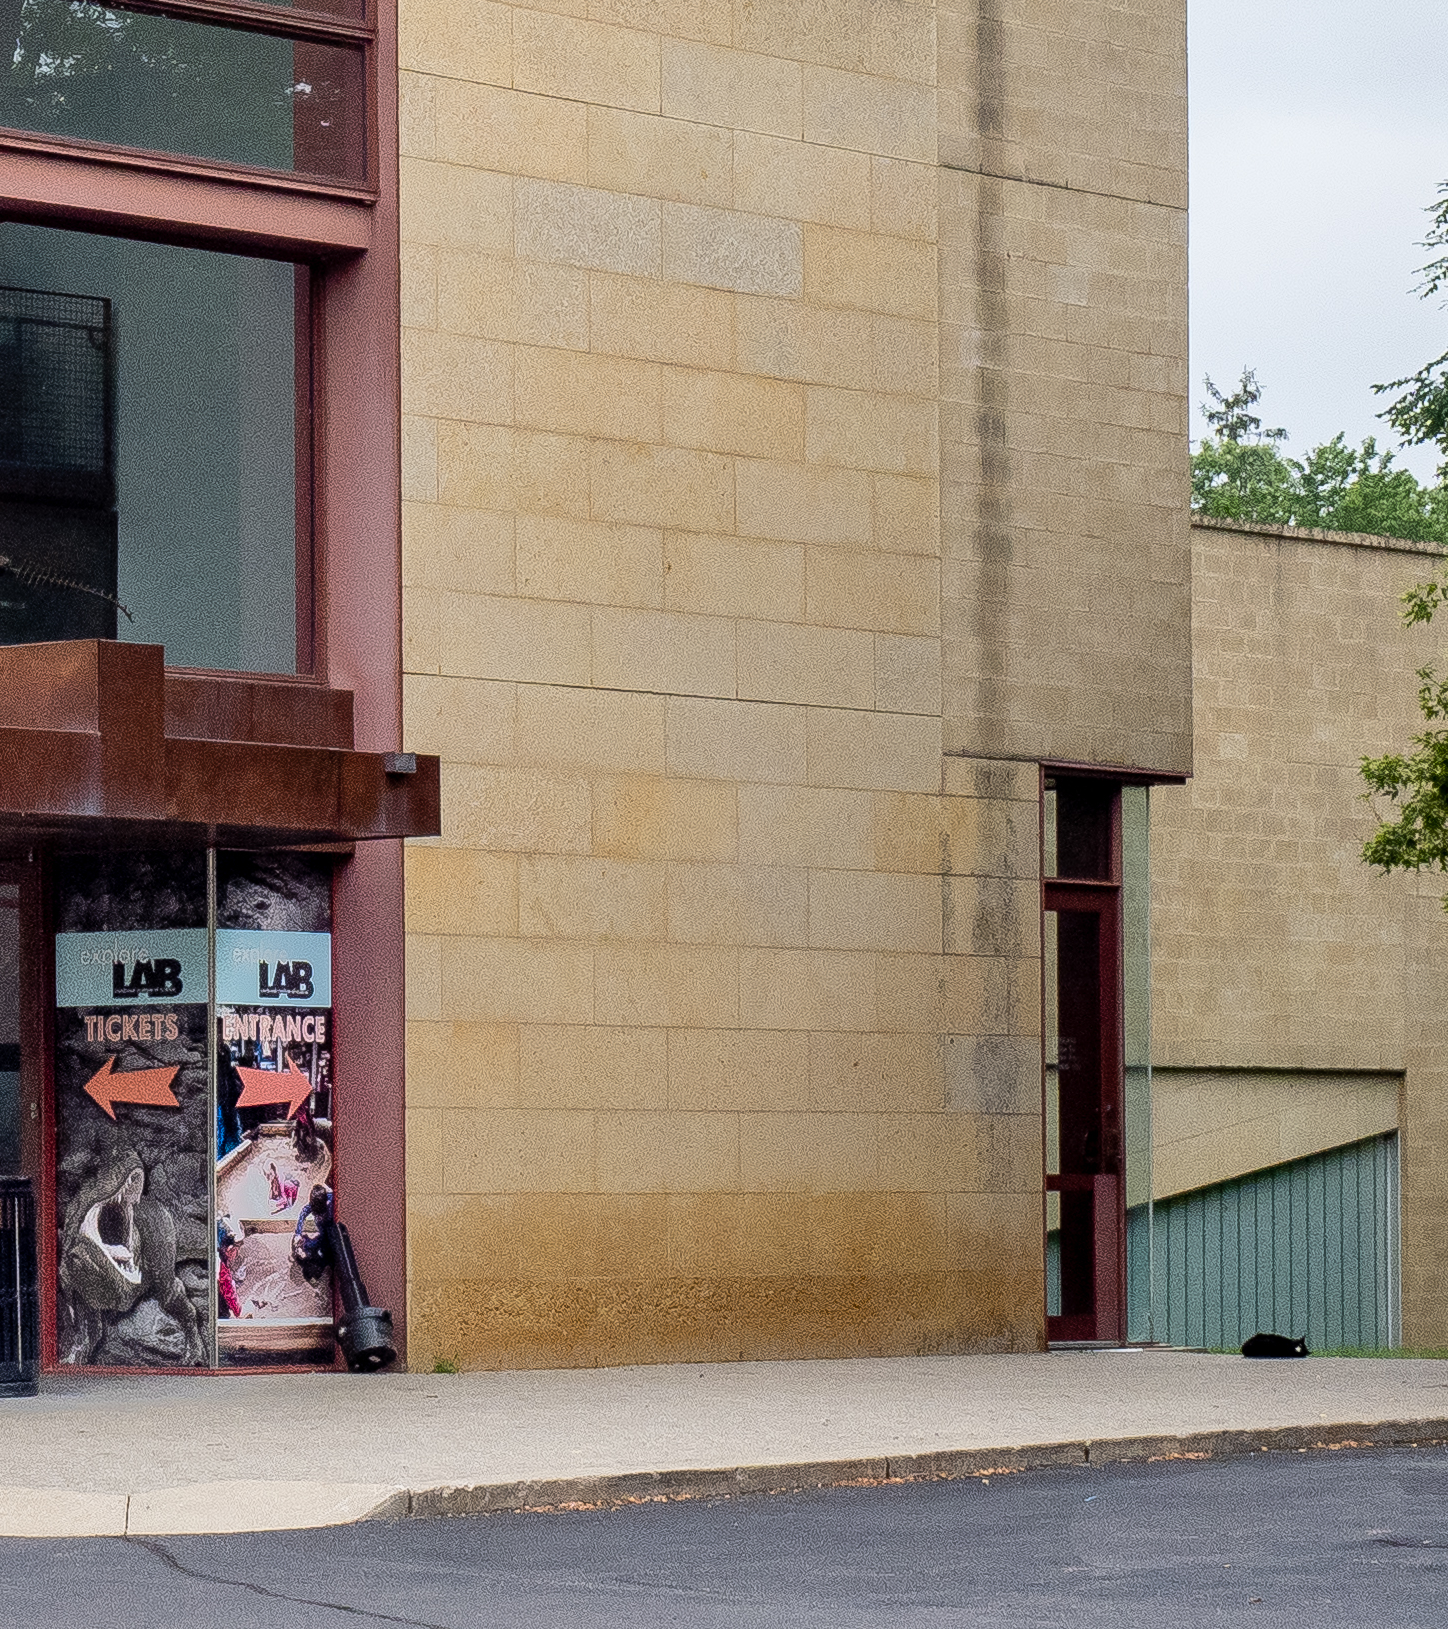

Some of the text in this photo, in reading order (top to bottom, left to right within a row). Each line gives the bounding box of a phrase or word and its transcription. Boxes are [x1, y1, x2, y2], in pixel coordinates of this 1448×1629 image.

[112, 957, 184, 999] LAB
[258, 958, 315, 1000] LAB
[83, 1013, 180, 1042] TICKETS
[222, 1013, 326, 1044] ENTRANCE
